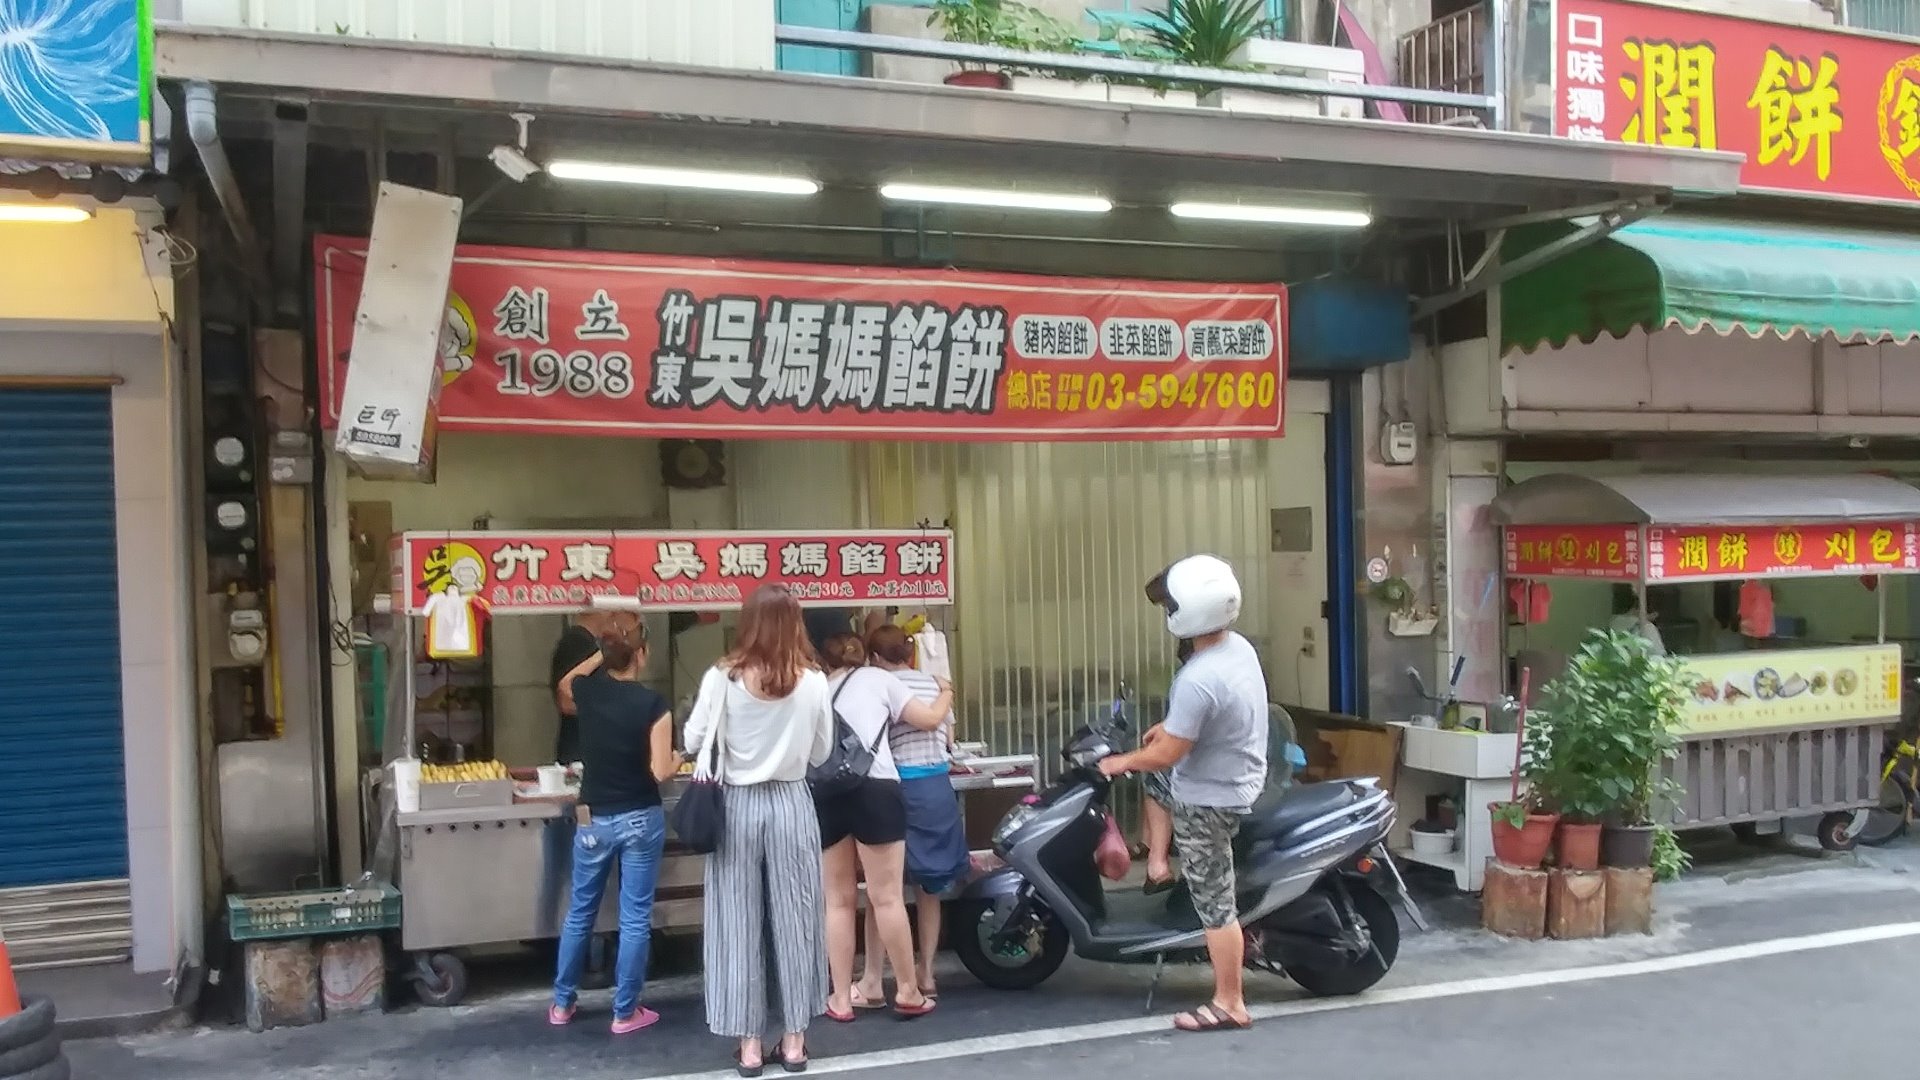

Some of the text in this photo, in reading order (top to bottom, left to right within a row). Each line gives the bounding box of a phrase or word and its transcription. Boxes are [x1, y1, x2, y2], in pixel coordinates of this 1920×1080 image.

[1619, 38, 1844, 181] 潤餅
[496, 287, 628, 344] 創立
[1024, 319, 1088, 355] 豬肉餡餅
[652, 294, 694, 403] 竹東
[690, 299, 1004, 409] 吳媽媽餡餅
[1110, 322, 1173, 357] 韭菜餡餅
[1191, 321, 1266, 357] 高麗菜餡餅
[496, 349, 634, 398] 1988
[1086, 371, 1275, 411] 03-5947660
[492, 540, 943, 581] 竹東 吳媽媽餡餅
[1678, 531, 1749, 572] 潤餅
[1824, 527, 1901, 564] 刈包
